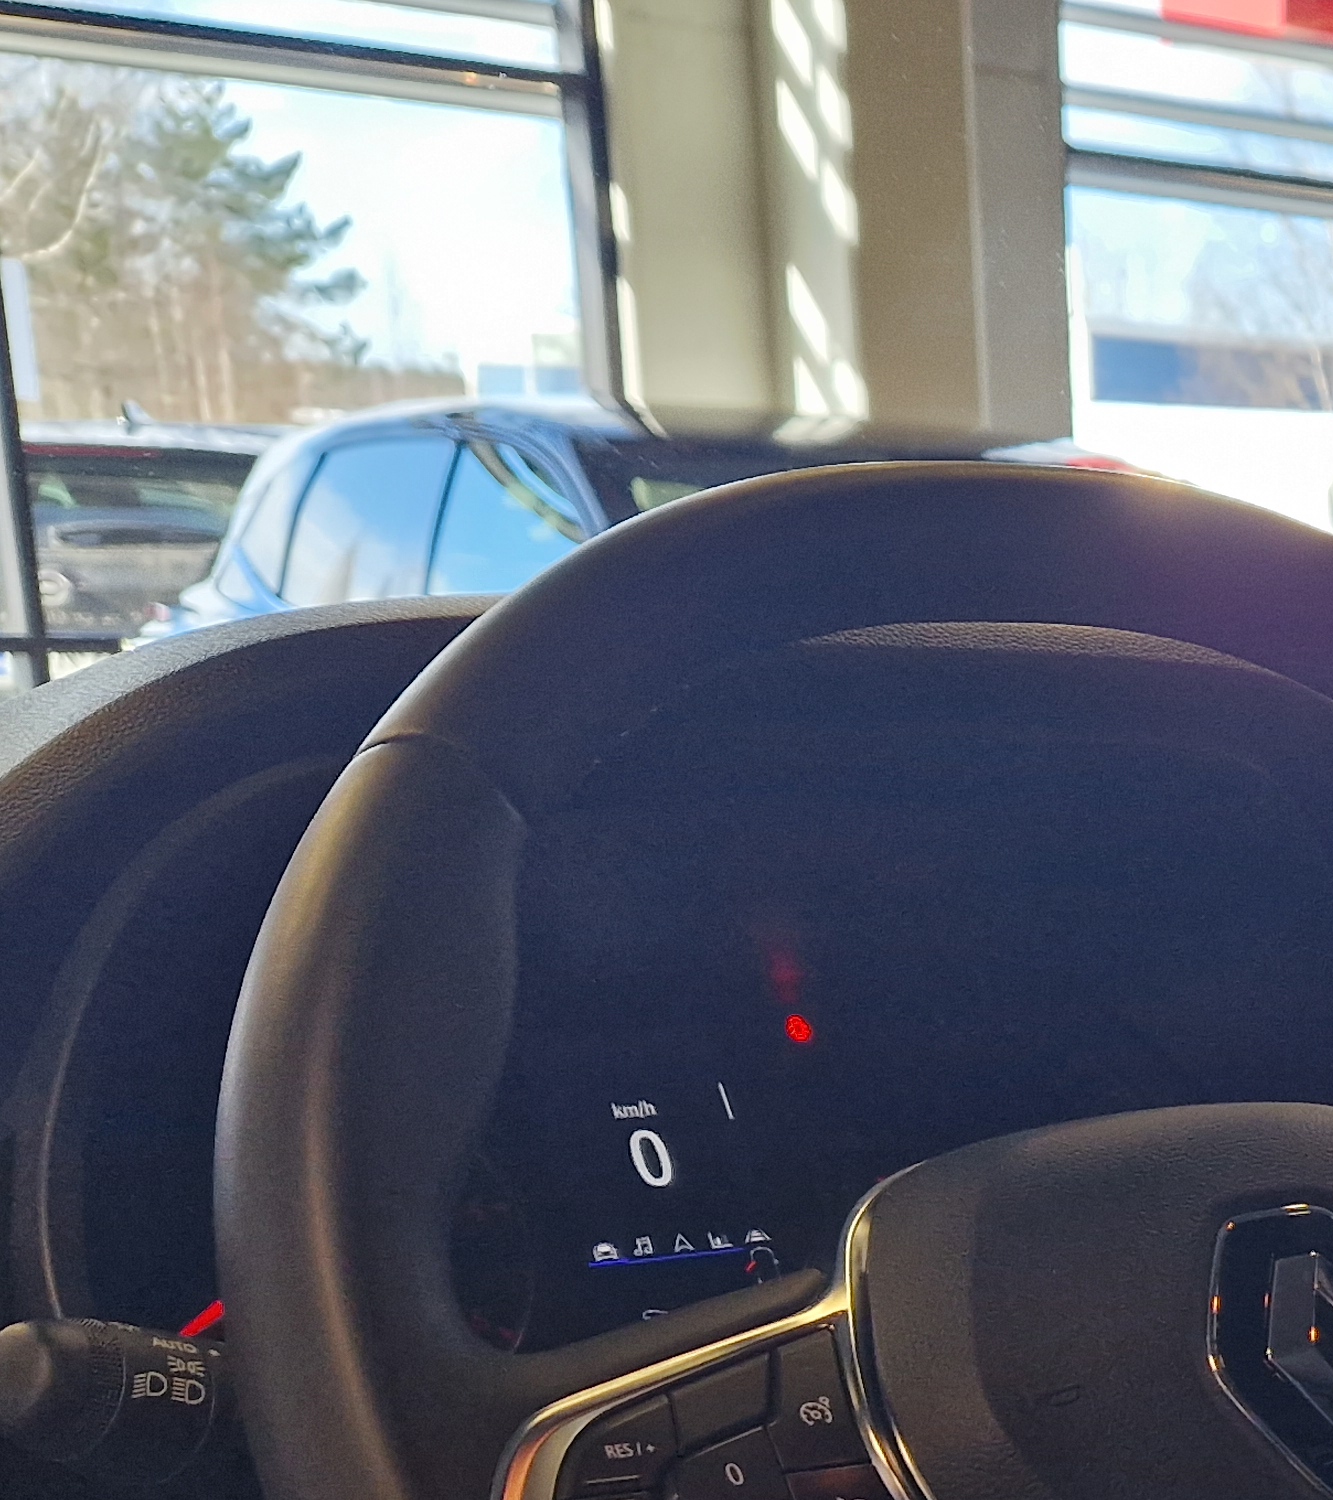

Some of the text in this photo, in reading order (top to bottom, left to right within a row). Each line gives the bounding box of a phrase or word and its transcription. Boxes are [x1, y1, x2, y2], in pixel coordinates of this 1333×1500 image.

[610, 1100, 658, 1121] km/h
[629, 1128, 675, 1189] 0
[152, 1337, 198, 1354] AUTO
[604, 1442, 634, 1460] RES
[724, 1461, 745, 1486] 0
